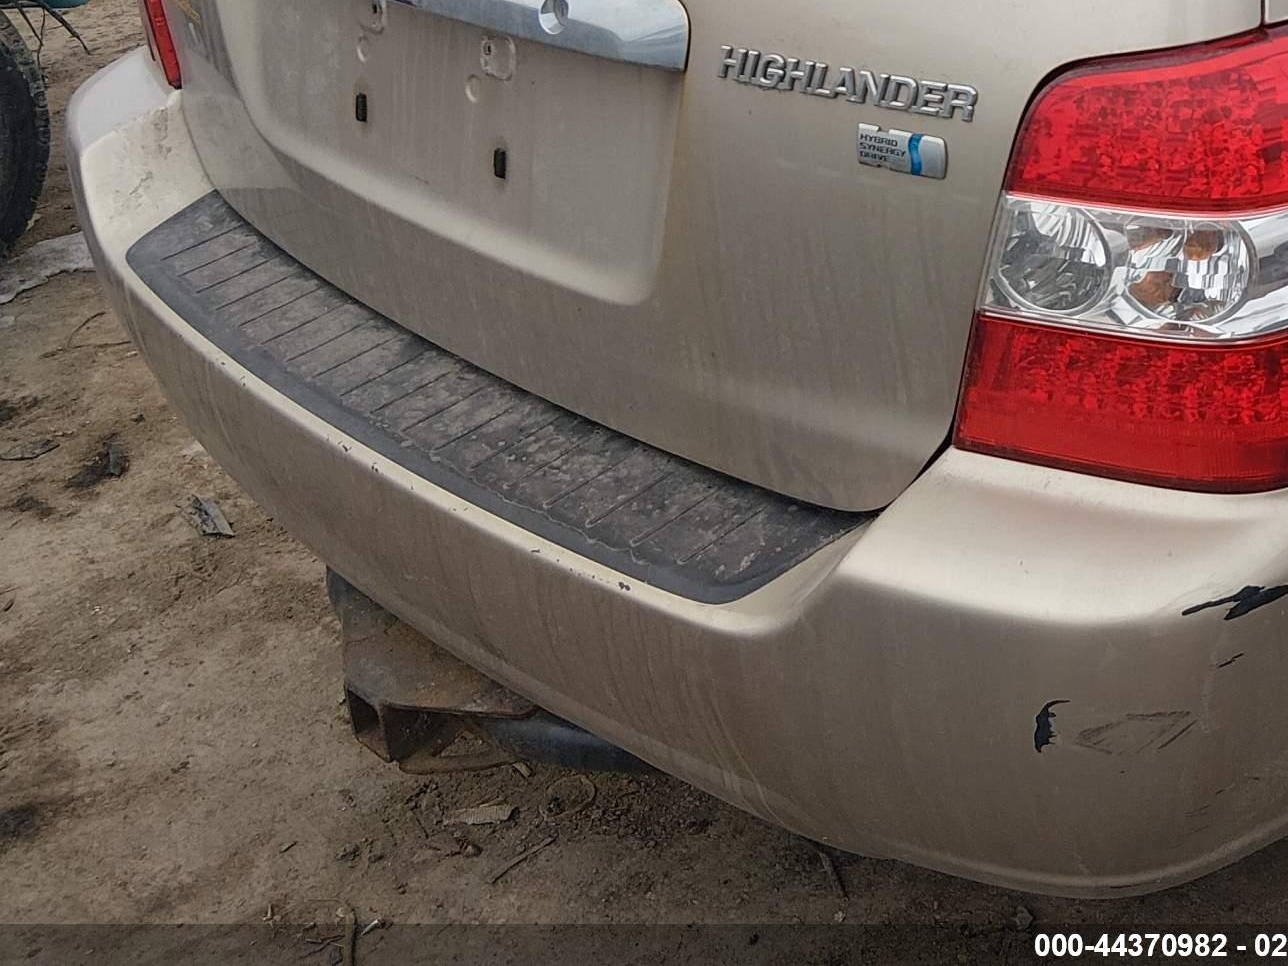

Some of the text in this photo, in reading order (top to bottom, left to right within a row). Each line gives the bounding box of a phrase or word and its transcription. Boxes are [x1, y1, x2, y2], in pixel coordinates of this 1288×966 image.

[718, 44, 979, 122] HIGHLANDER
[859, 133, 898, 147] HYBRID
[859, 141, 906, 157] SYNERGY
[859, 150, 890, 162] DRIVE
